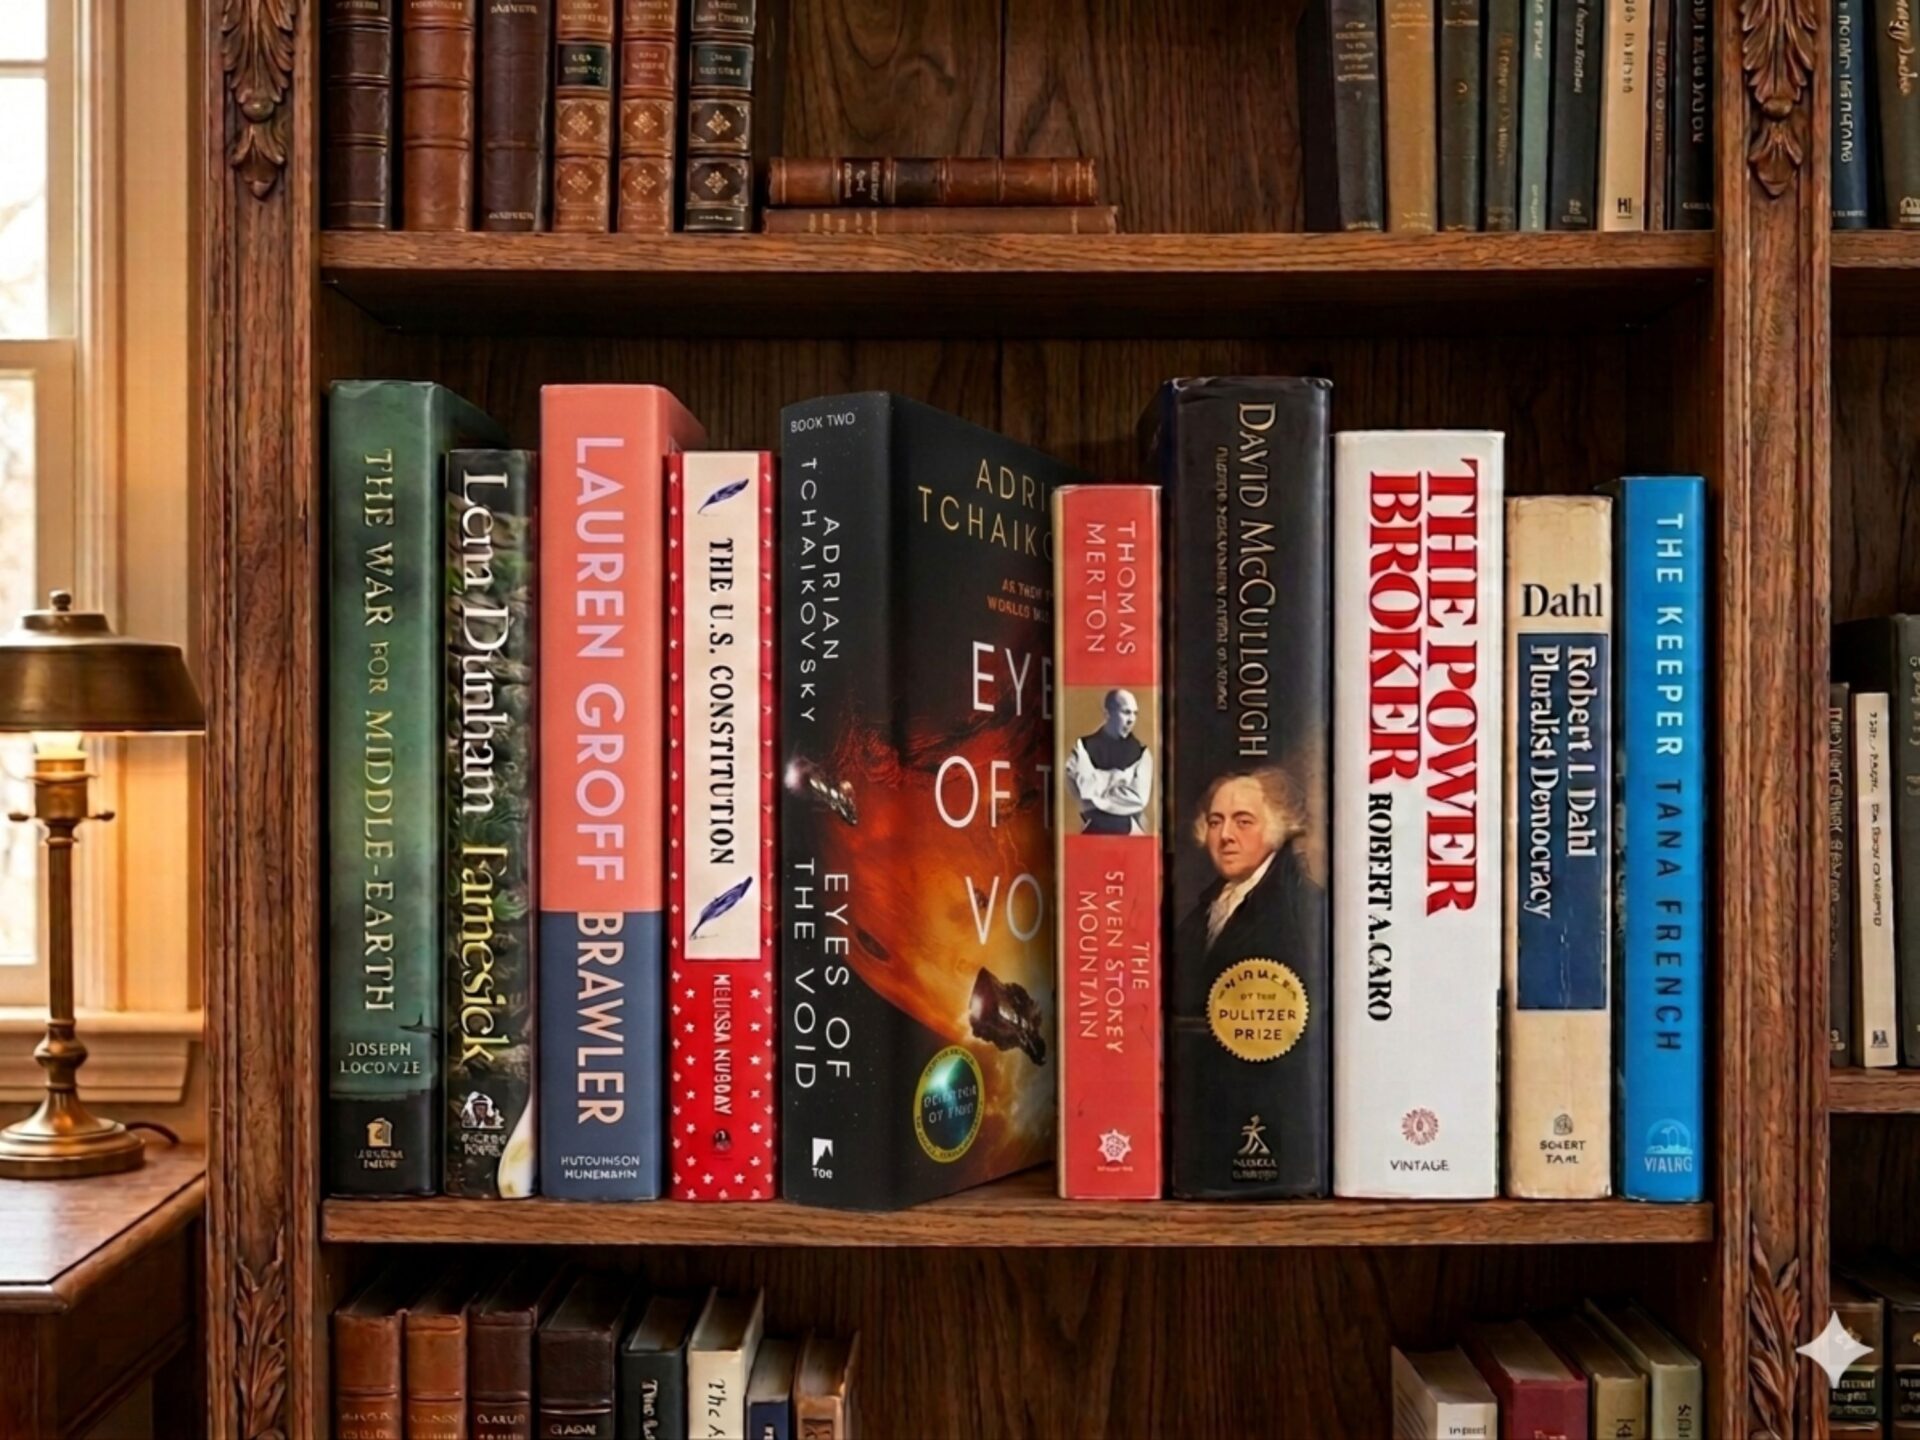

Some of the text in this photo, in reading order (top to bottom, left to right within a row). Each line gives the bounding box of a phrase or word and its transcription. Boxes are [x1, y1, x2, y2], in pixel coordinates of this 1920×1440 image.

[790, 411, 856, 433] BOOK TWO
[1237, 401, 1278, 508] DAVID
[460, 471, 510, 815] Lena Dunham
[575, 436, 626, 881] LAUREN GROFF
[799, 457, 841, 722] ADRIAN TCHAIKOVSKY
[1085, 522, 1108, 653] MERTON
[1115, 519, 1138, 656] THOMAS
[1368, 469, 1422, 784] BROKER
[1521, 582, 1604, 619] Dahl
[363, 448, 396, 1012] THE WAR FOR MIDDLE-EARTH
[708, 537, 735, 865] THE U.S. CONSTITUTION
[1425, 457, 1480, 916] THE POWER
[1566, 645, 1599, 752] Robert
[934, 755, 1012, 829] OF
[1367, 791, 1394, 912] ROBERT
[1522, 644, 1562, 919] Pluralist Democracy
[1566, 788, 1599, 858] Dahl
[1655, 513, 1684, 1052] THE KEEPER TANA FRENCH
[793, 857, 817, 1089] THE VOID
[824, 873, 852, 1079] EYES OF
[1075, 890, 1100, 1039] MOUNTAIN
[1105, 870, 1125, 948] SEVEN
[1130, 941, 1151, 990] THE
[576, 911, 625, 1125] BRAWLER
